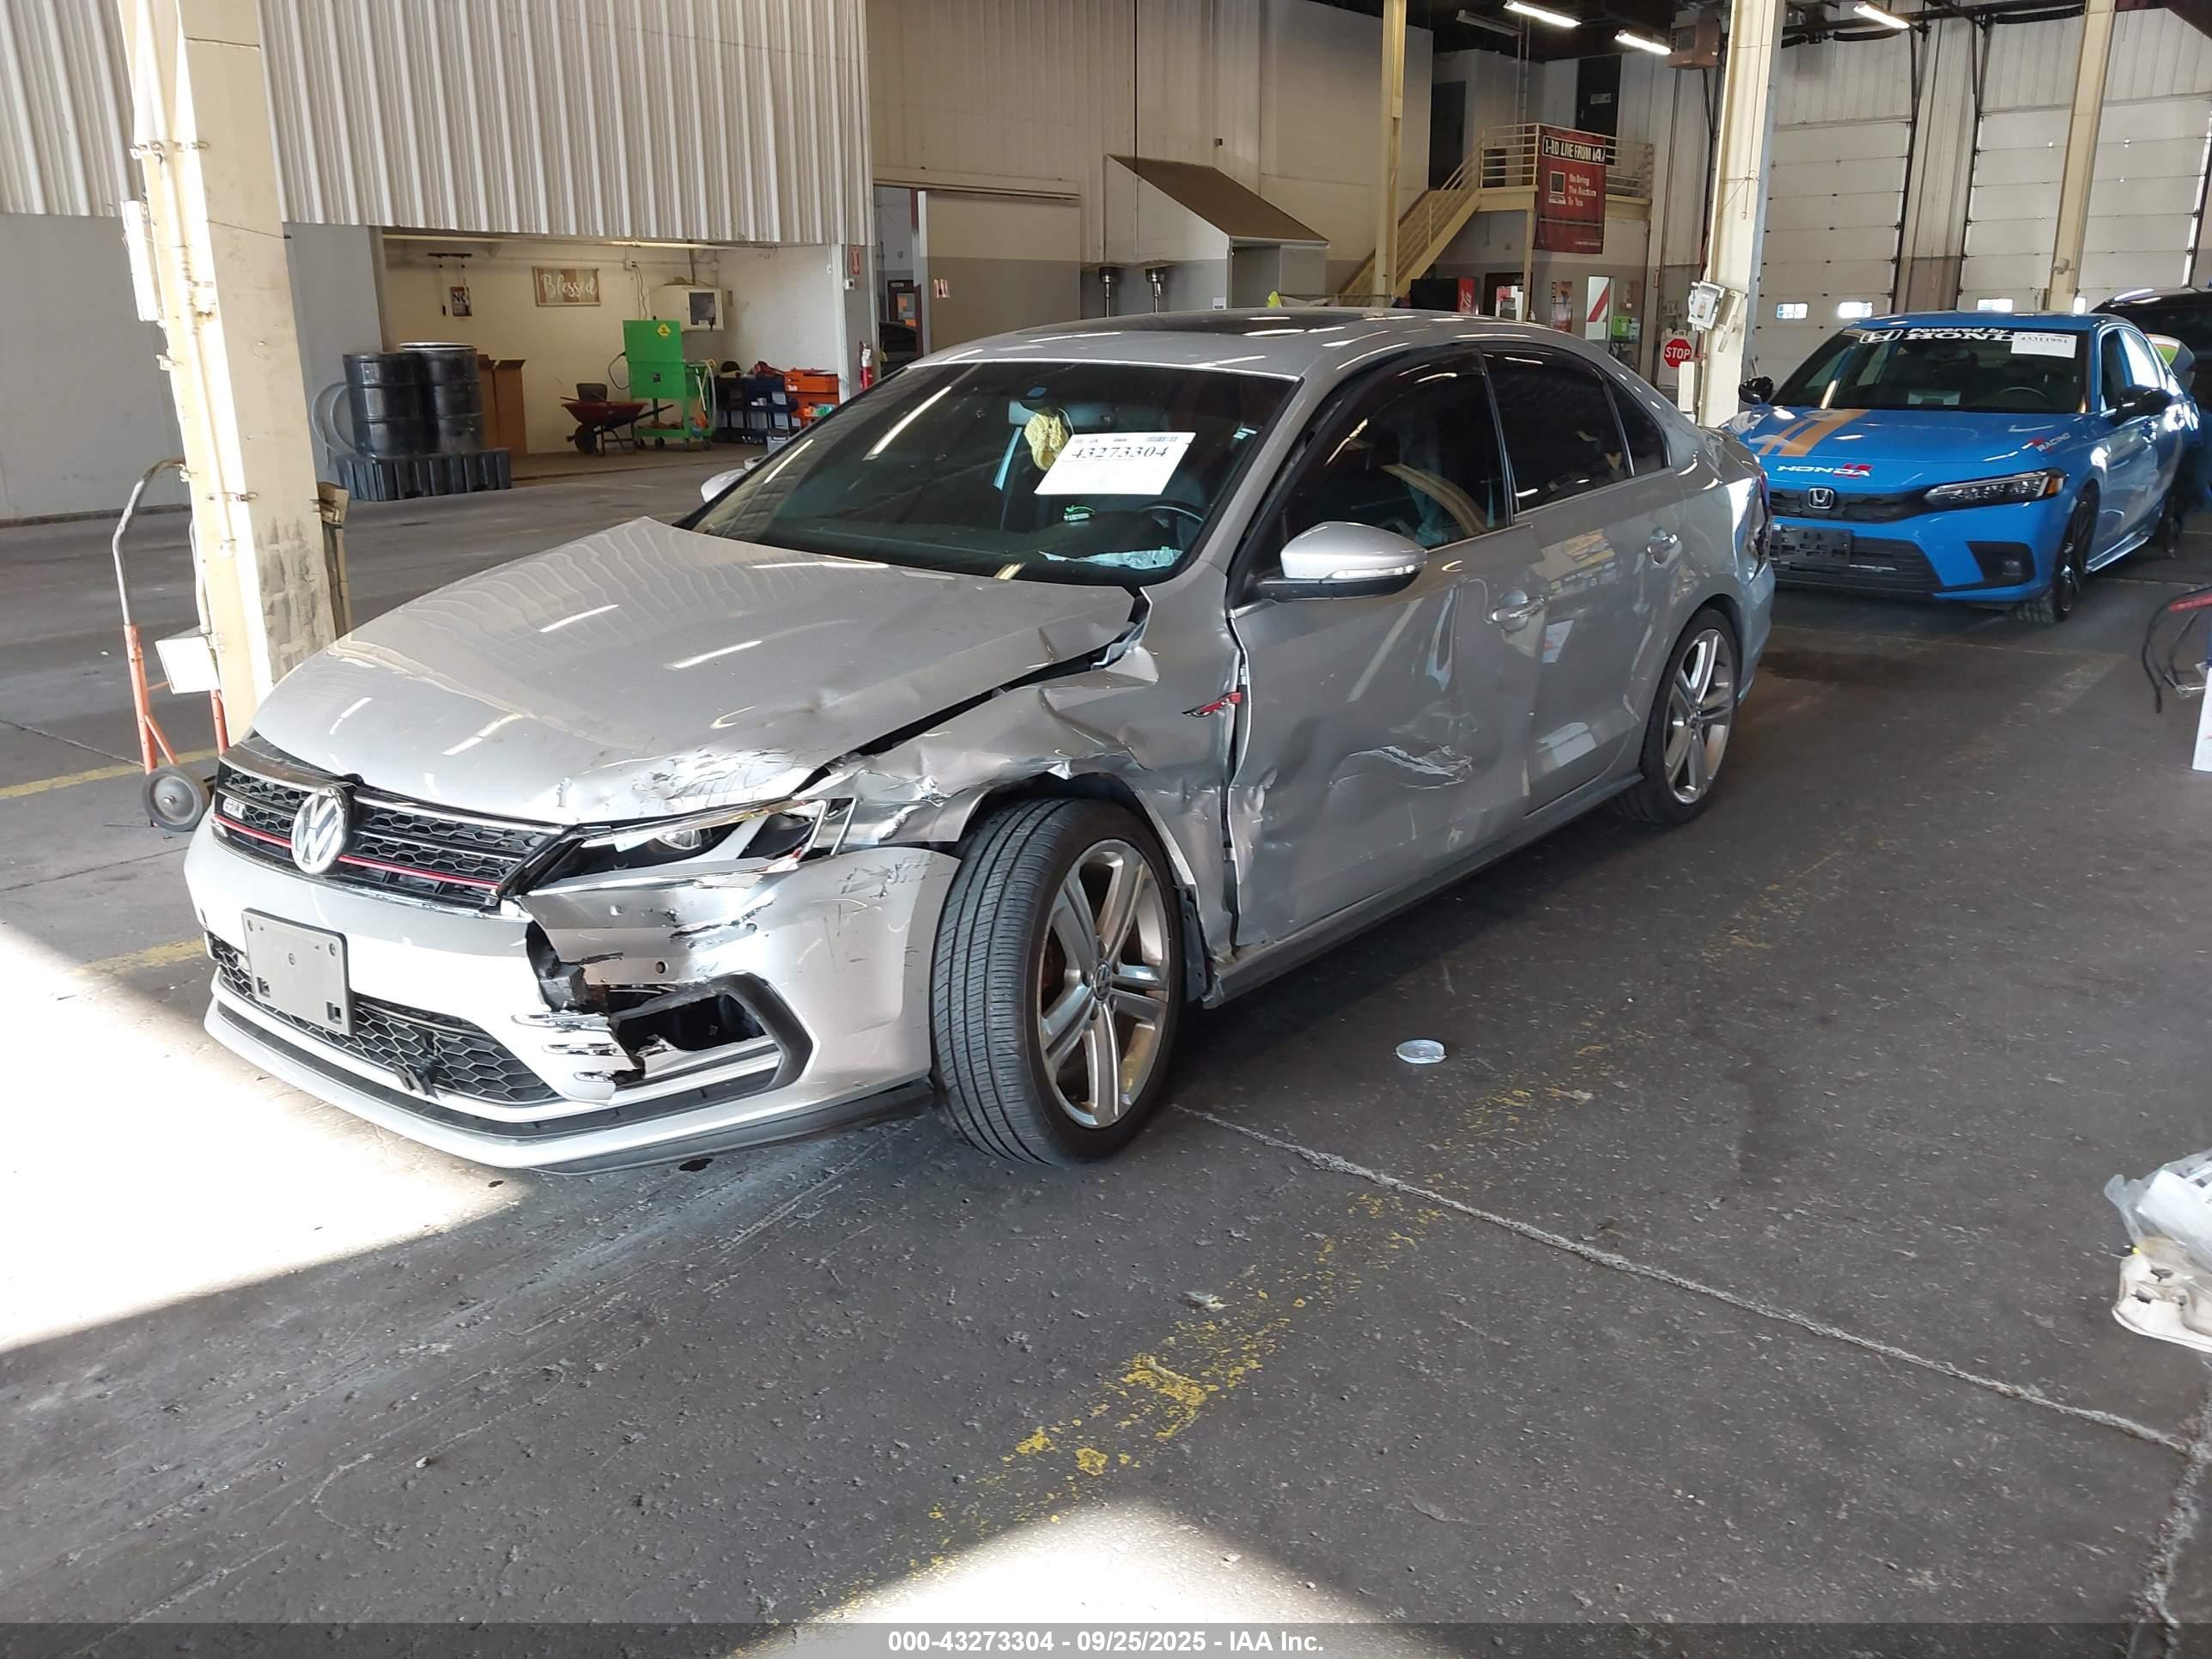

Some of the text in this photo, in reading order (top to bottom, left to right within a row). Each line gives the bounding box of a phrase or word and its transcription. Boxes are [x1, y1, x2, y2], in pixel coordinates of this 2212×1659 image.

[1560, 142, 1574, 158] LIVE
[1574, 144, 1591, 161] FROM
[541, 274, 597, 297] Blessed
[1904, 331, 2014, 342] HOND
[1664, 346, 1691, 360] STOP
[1071, 446, 1170, 459] 43273304
[1777, 465, 1870, 477] HONDA
